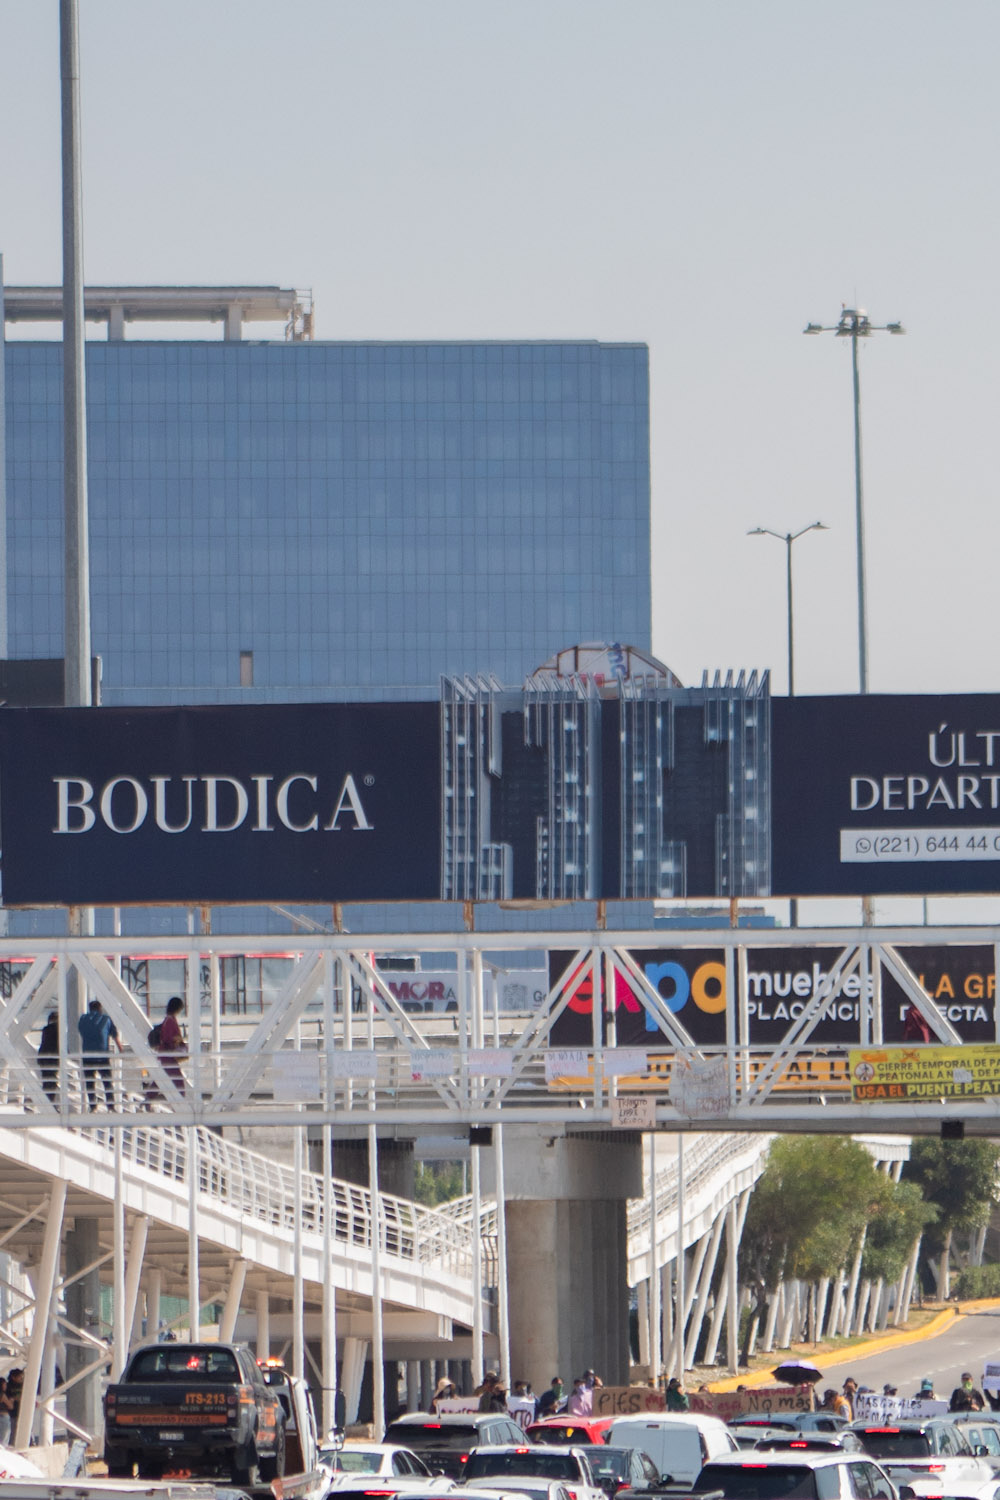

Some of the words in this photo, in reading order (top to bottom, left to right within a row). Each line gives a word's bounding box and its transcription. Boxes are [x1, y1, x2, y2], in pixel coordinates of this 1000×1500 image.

[872, 834, 921, 856] (221)
[926, 833, 959, 854] 644
[963, 833, 989, 854] 44
[877, 1062, 913, 1072] CIERRE
[916, 1060, 973, 1071] TEMPORAL
[974, 1059, 988, 1069] DE
[878, 1071, 935, 1082] PEATONAL
[937, 1070, 945, 1079] A
[856, 1085, 887, 1098] USA
[891, 1085, 905, 1098] EL
[907, 1082, 962, 1097] PUENTE
[185, 1393, 225, 1405] ITS-213
